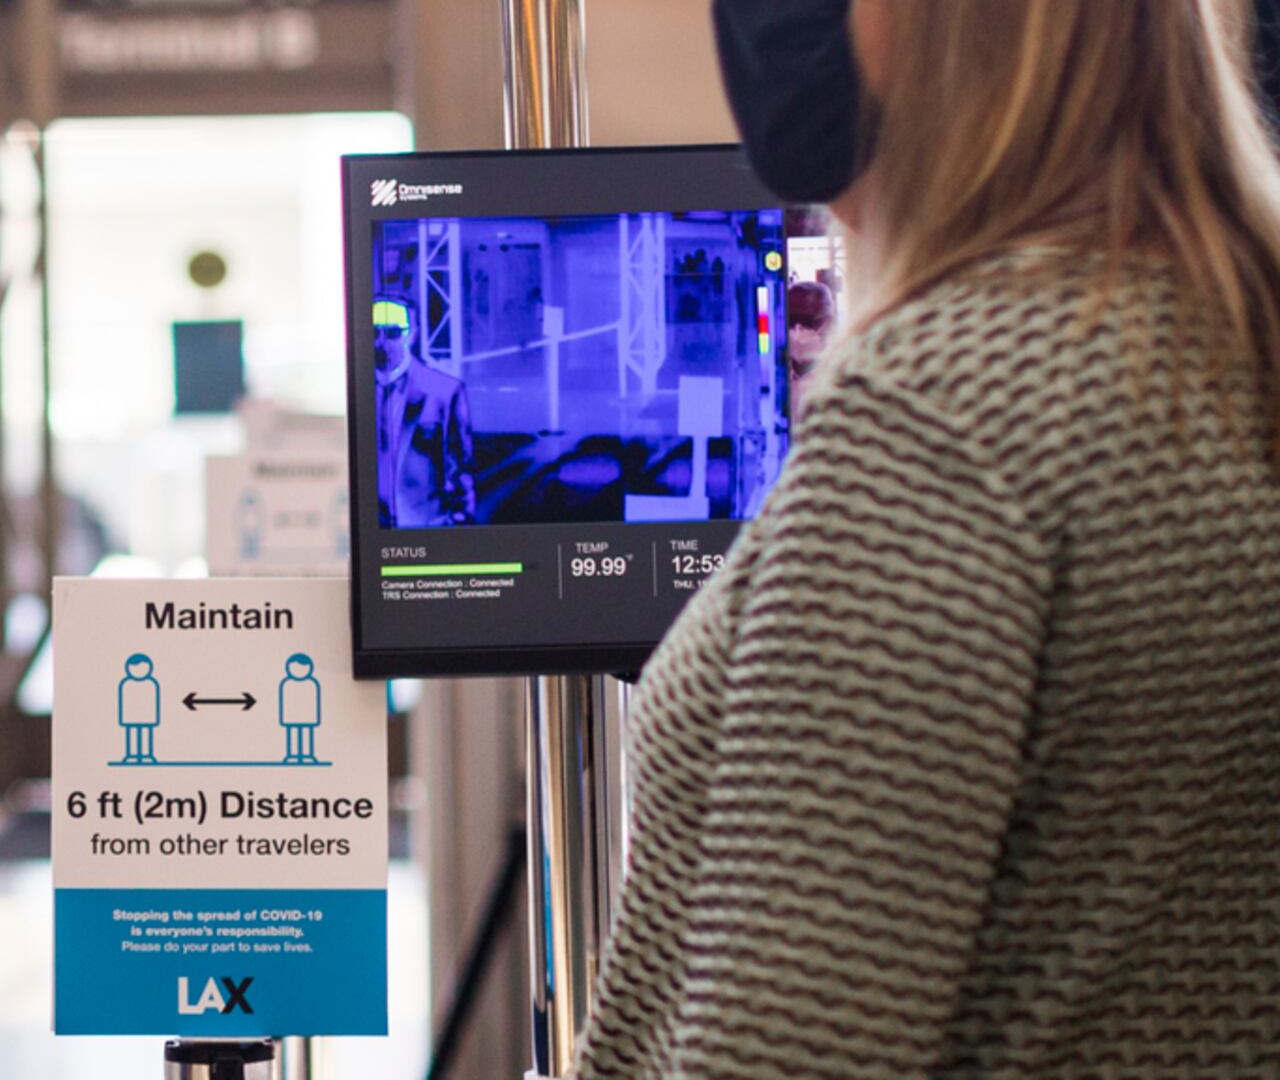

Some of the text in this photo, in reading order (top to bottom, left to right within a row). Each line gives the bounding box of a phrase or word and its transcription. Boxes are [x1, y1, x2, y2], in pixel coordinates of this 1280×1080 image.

[576, 542, 609, 554] TEMP
[670, 539, 698, 551] TIME
[381, 547, 427, 558] STATUS
[671, 553, 725, 574] 12:53
[381, 581, 415, 589] Camera
[416, 579, 463, 589] Connection
[469, 577, 514, 587] Connected
[402, 589, 450, 599] Connection
[455, 588, 501, 598] Connected
[145, 602, 293, 629] Maintain
[66, 790, 374, 825] 6 ft (2m) Distance
[90, 833, 351, 856] from other travelers
[112, 908, 323, 923] Stopping the spread of COVID-19
[131, 925, 142, 936] is
[216, 925, 304, 938] responsibility.
[121, 941, 314, 954] Please do your part to save lives.
[178, 976, 255, 1014] LAX
